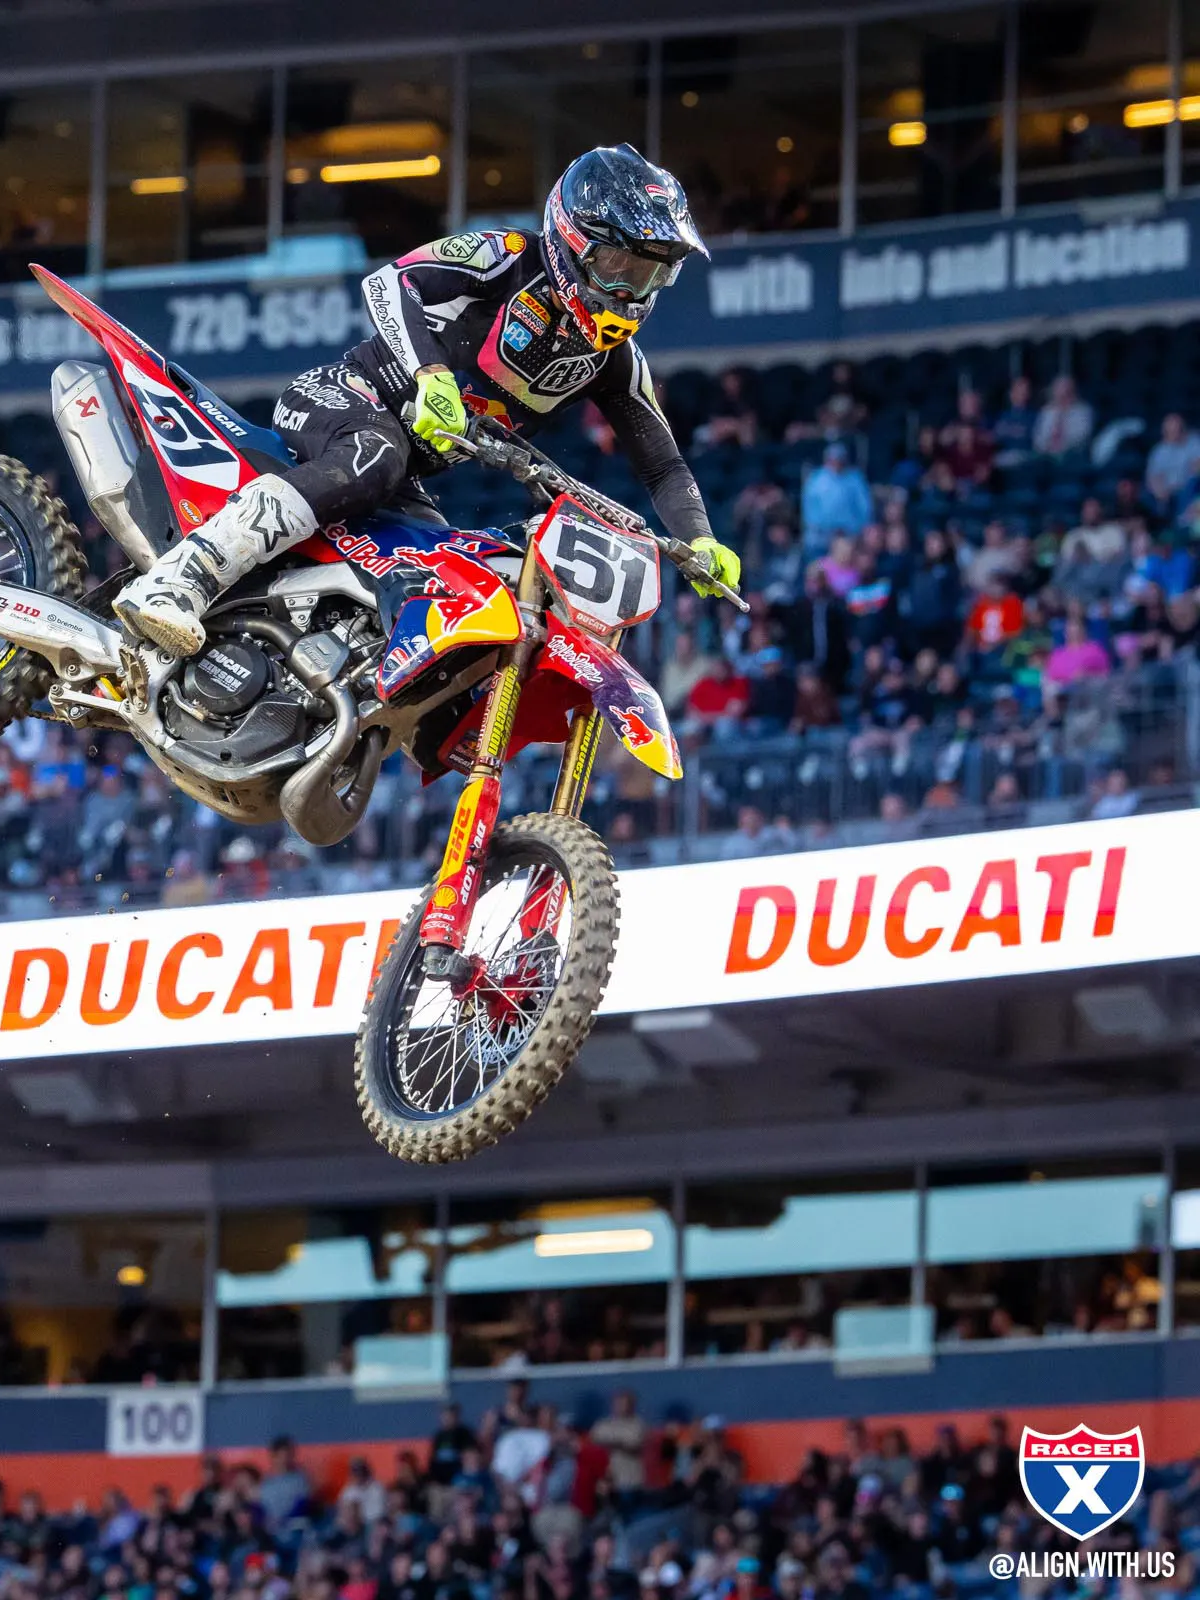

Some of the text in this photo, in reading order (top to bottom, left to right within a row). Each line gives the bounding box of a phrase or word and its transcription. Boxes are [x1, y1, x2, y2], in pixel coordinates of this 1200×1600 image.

[368, 276, 388, 304] Troy
[708, 220, 1189, 319] with info and location
[166, 287, 374, 356] 720-650-
[374, 299, 391, 322] Lee
[524, 295, 550, 321] DHL
[507, 325, 529, 348] PPG
[127, 382, 238, 467] 51
[198, 400, 248, 437] DUCATI
[324, 520, 400, 578] ed Bull
[553, 524, 647, 620] 51
[13, 603, 41, 618] DID
[57, 618, 83, 632] brembo
[575, 612, 607, 633] DUCATI
[207, 648, 252, 679] DUCATI
[487, 663, 519, 756] Connection
[446, 807, 471, 865] DHL
[460, 818, 487, 906] DULOP
[723, 846, 1127, 974] DUCATI
[122, 1401, 194, 1445] 100
